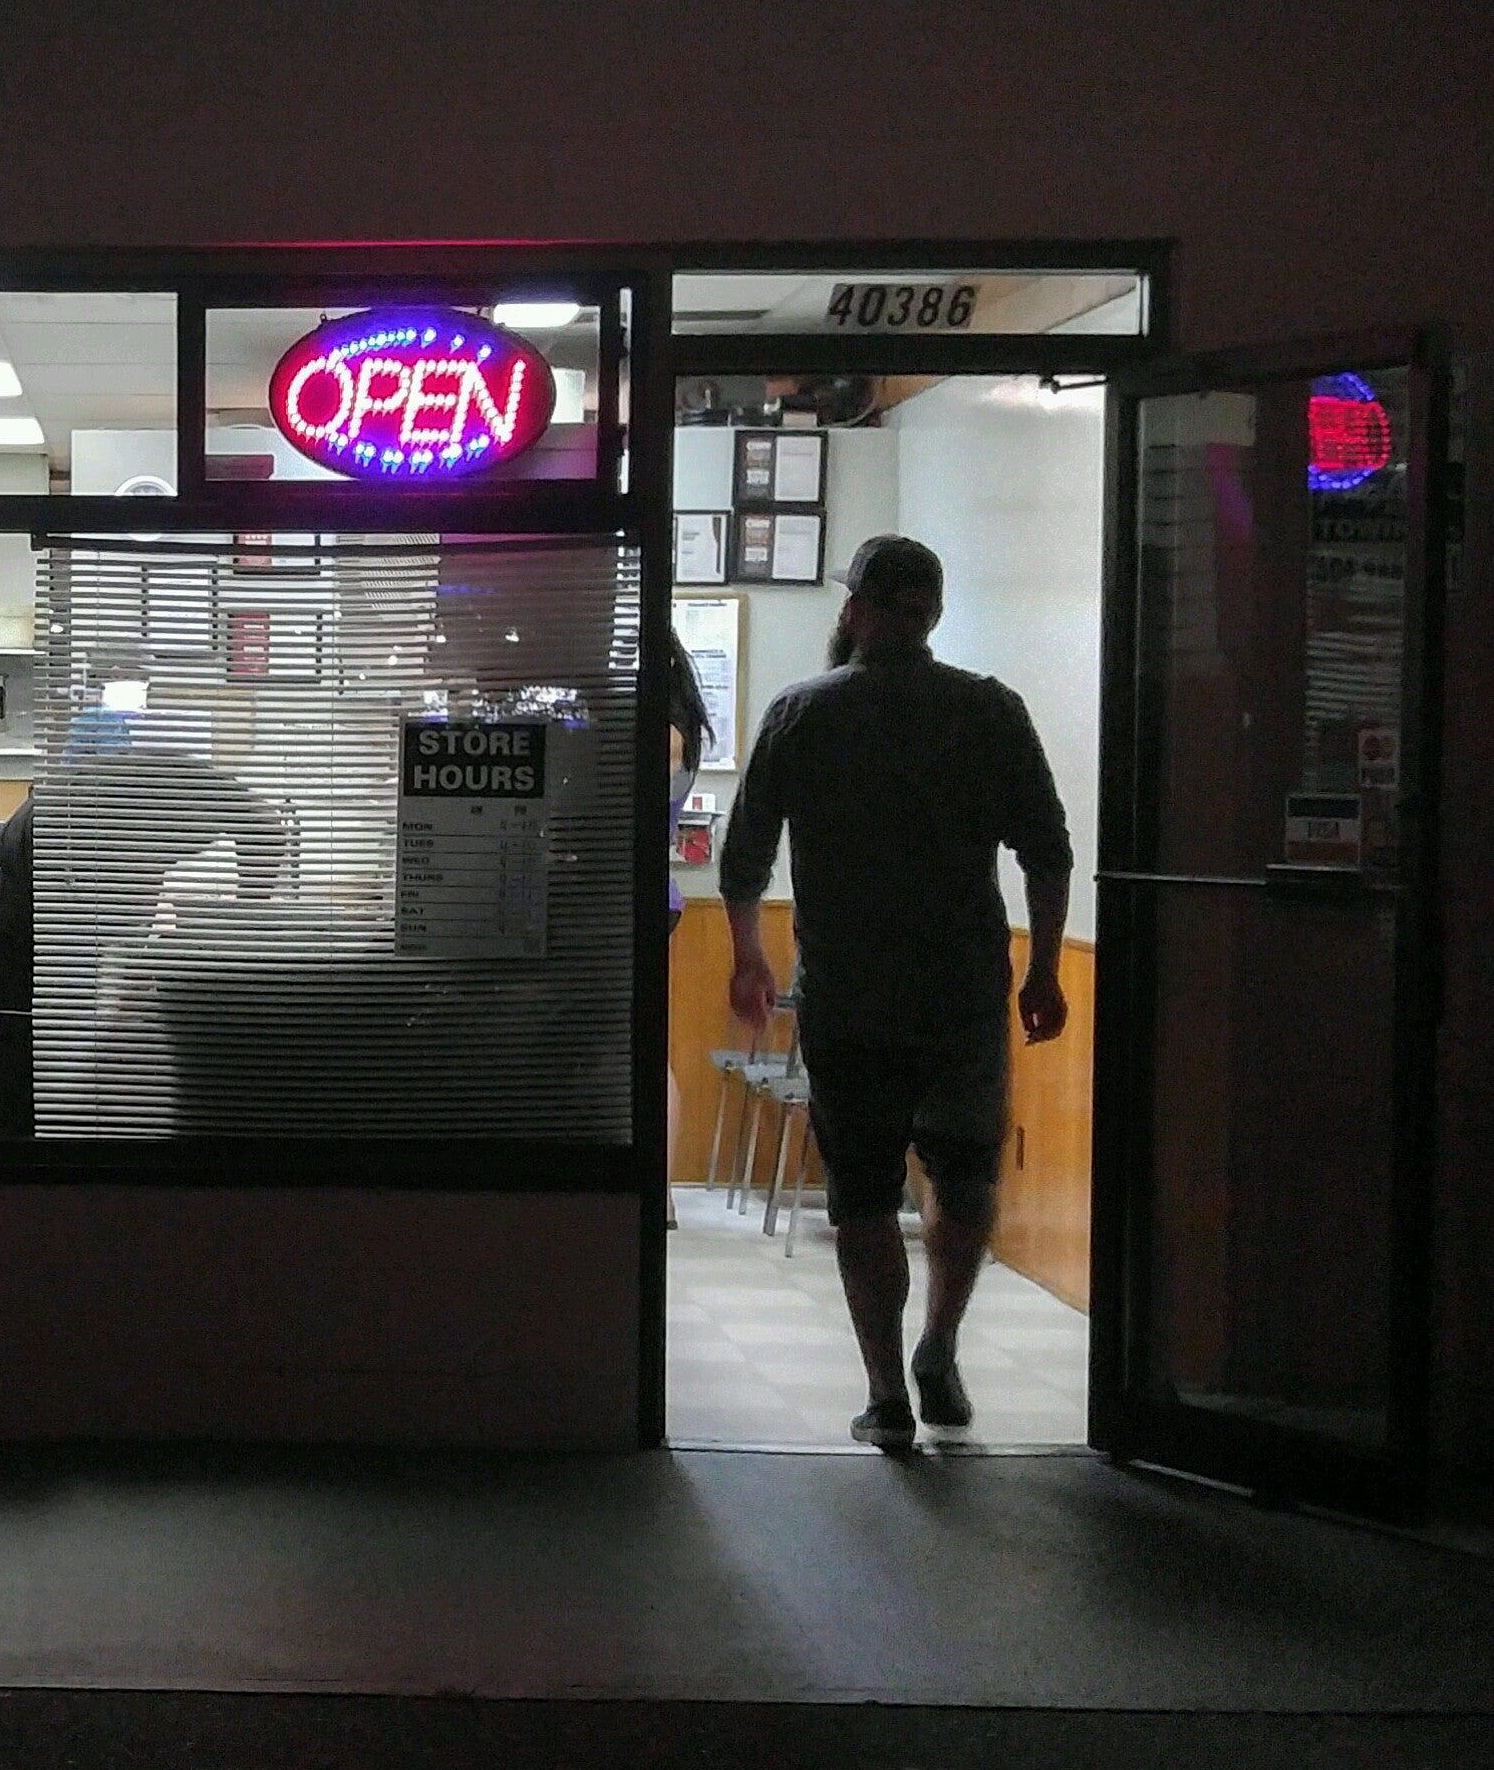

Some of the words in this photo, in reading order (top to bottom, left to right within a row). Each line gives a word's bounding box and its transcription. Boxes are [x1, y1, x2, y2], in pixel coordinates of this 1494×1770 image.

[828, 284, 976, 328] 40386
[286, 355, 527, 447] OPEN
[418, 729, 532, 756] STORE
[413, 764, 535, 791] HOURS
